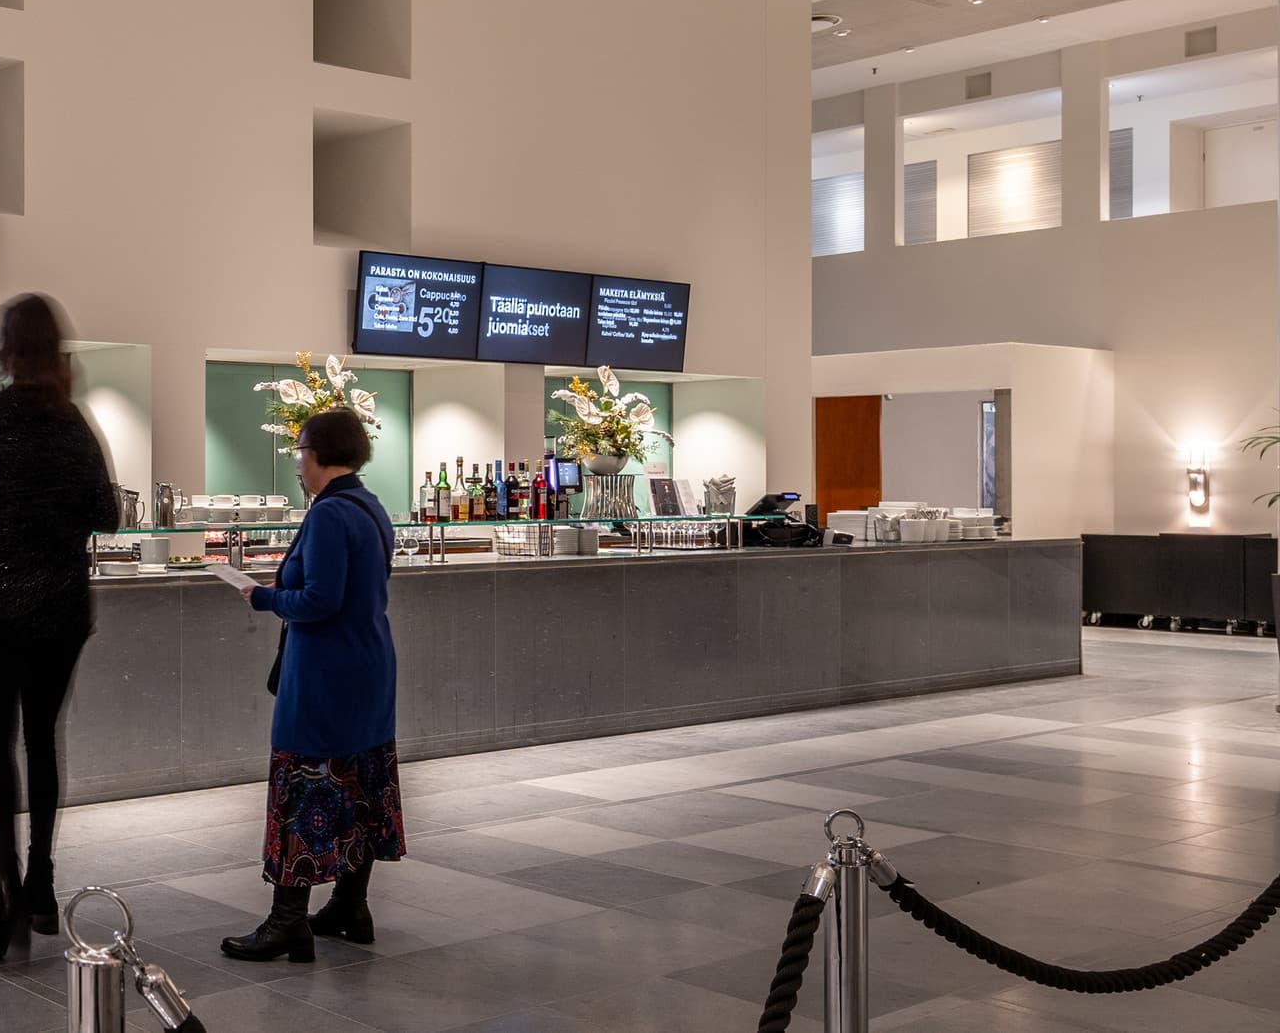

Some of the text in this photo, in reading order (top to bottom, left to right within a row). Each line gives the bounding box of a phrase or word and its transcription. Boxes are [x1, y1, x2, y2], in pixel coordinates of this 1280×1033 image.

[370, 266, 477, 284] PARASTA ON KOKONAISUUS
[599, 287, 666, 301] MAKEITA ELÄMYKSIÄ
[526, 302, 580, 319] punotaan
